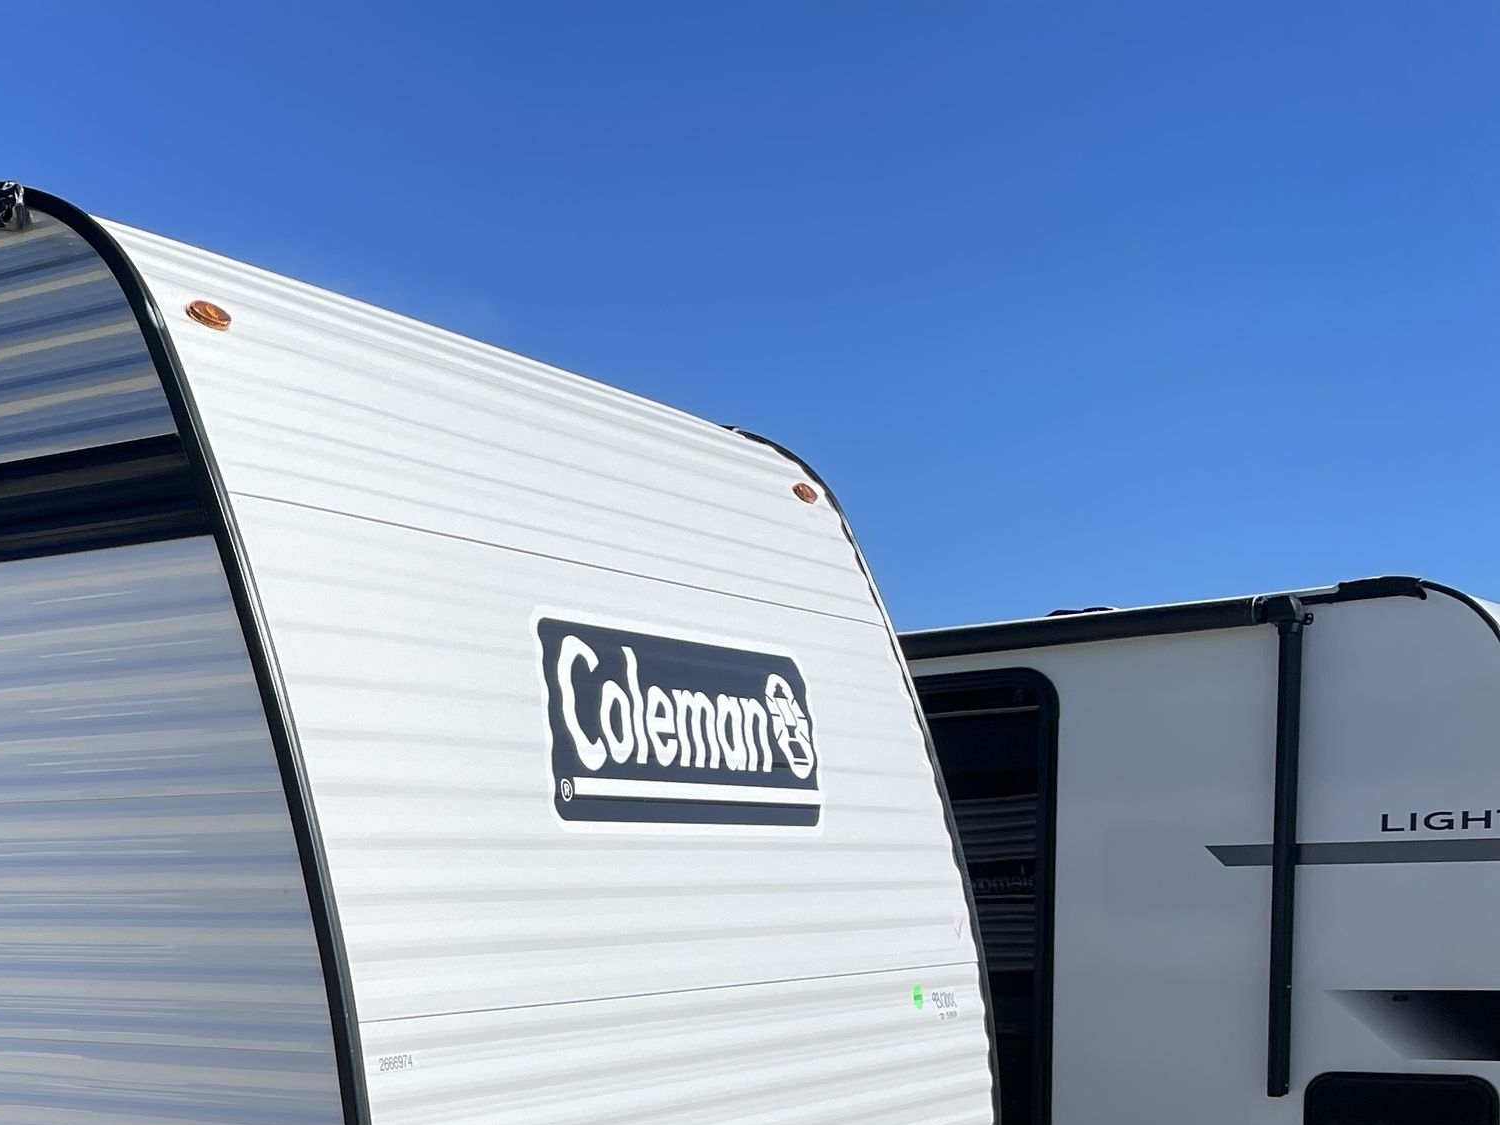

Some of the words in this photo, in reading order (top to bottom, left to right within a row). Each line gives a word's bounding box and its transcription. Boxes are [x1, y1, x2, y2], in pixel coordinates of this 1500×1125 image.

[557, 634, 773, 773] Coleman
[1381, 809, 1500, 832] LIGH
[379, 1054, 413, 1071] 2666974
